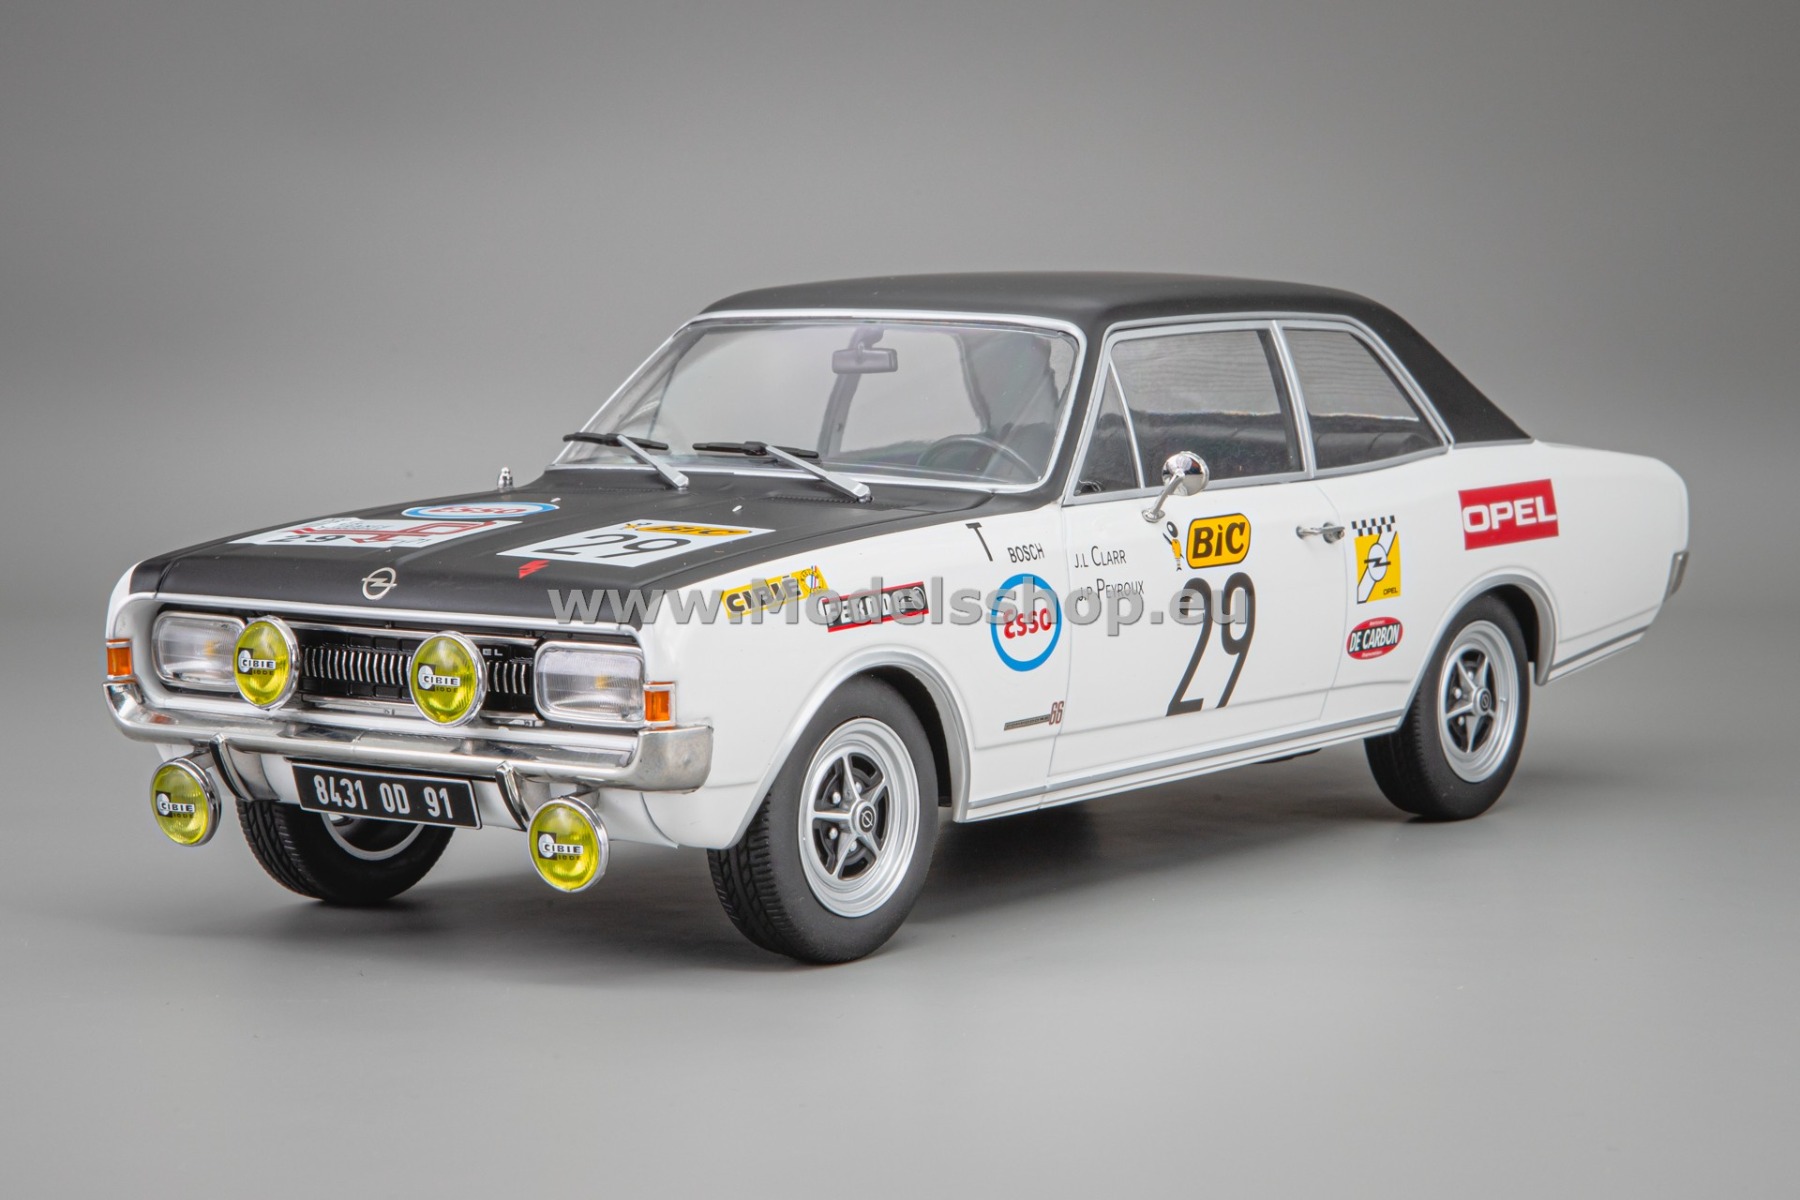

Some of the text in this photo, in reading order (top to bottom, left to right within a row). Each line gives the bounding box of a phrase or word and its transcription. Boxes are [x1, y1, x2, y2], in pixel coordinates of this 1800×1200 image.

[1461, 496, 1558, 533] OPEL
[533, 533, 692, 559] 29
[1007, 543, 1045, 563] BOSCH
[1165, 571, 1256, 718] 29
[1349, 624, 1400, 653] DE CARBON
[242, 659, 275, 669] CIBIE
[423, 675, 459, 686] CIBIE
[161, 802, 194, 812] CIBIE
[313, 774, 369, 810] 8431
[424, 786, 454, 819] 91
[544, 843, 582, 854] CIBIE
